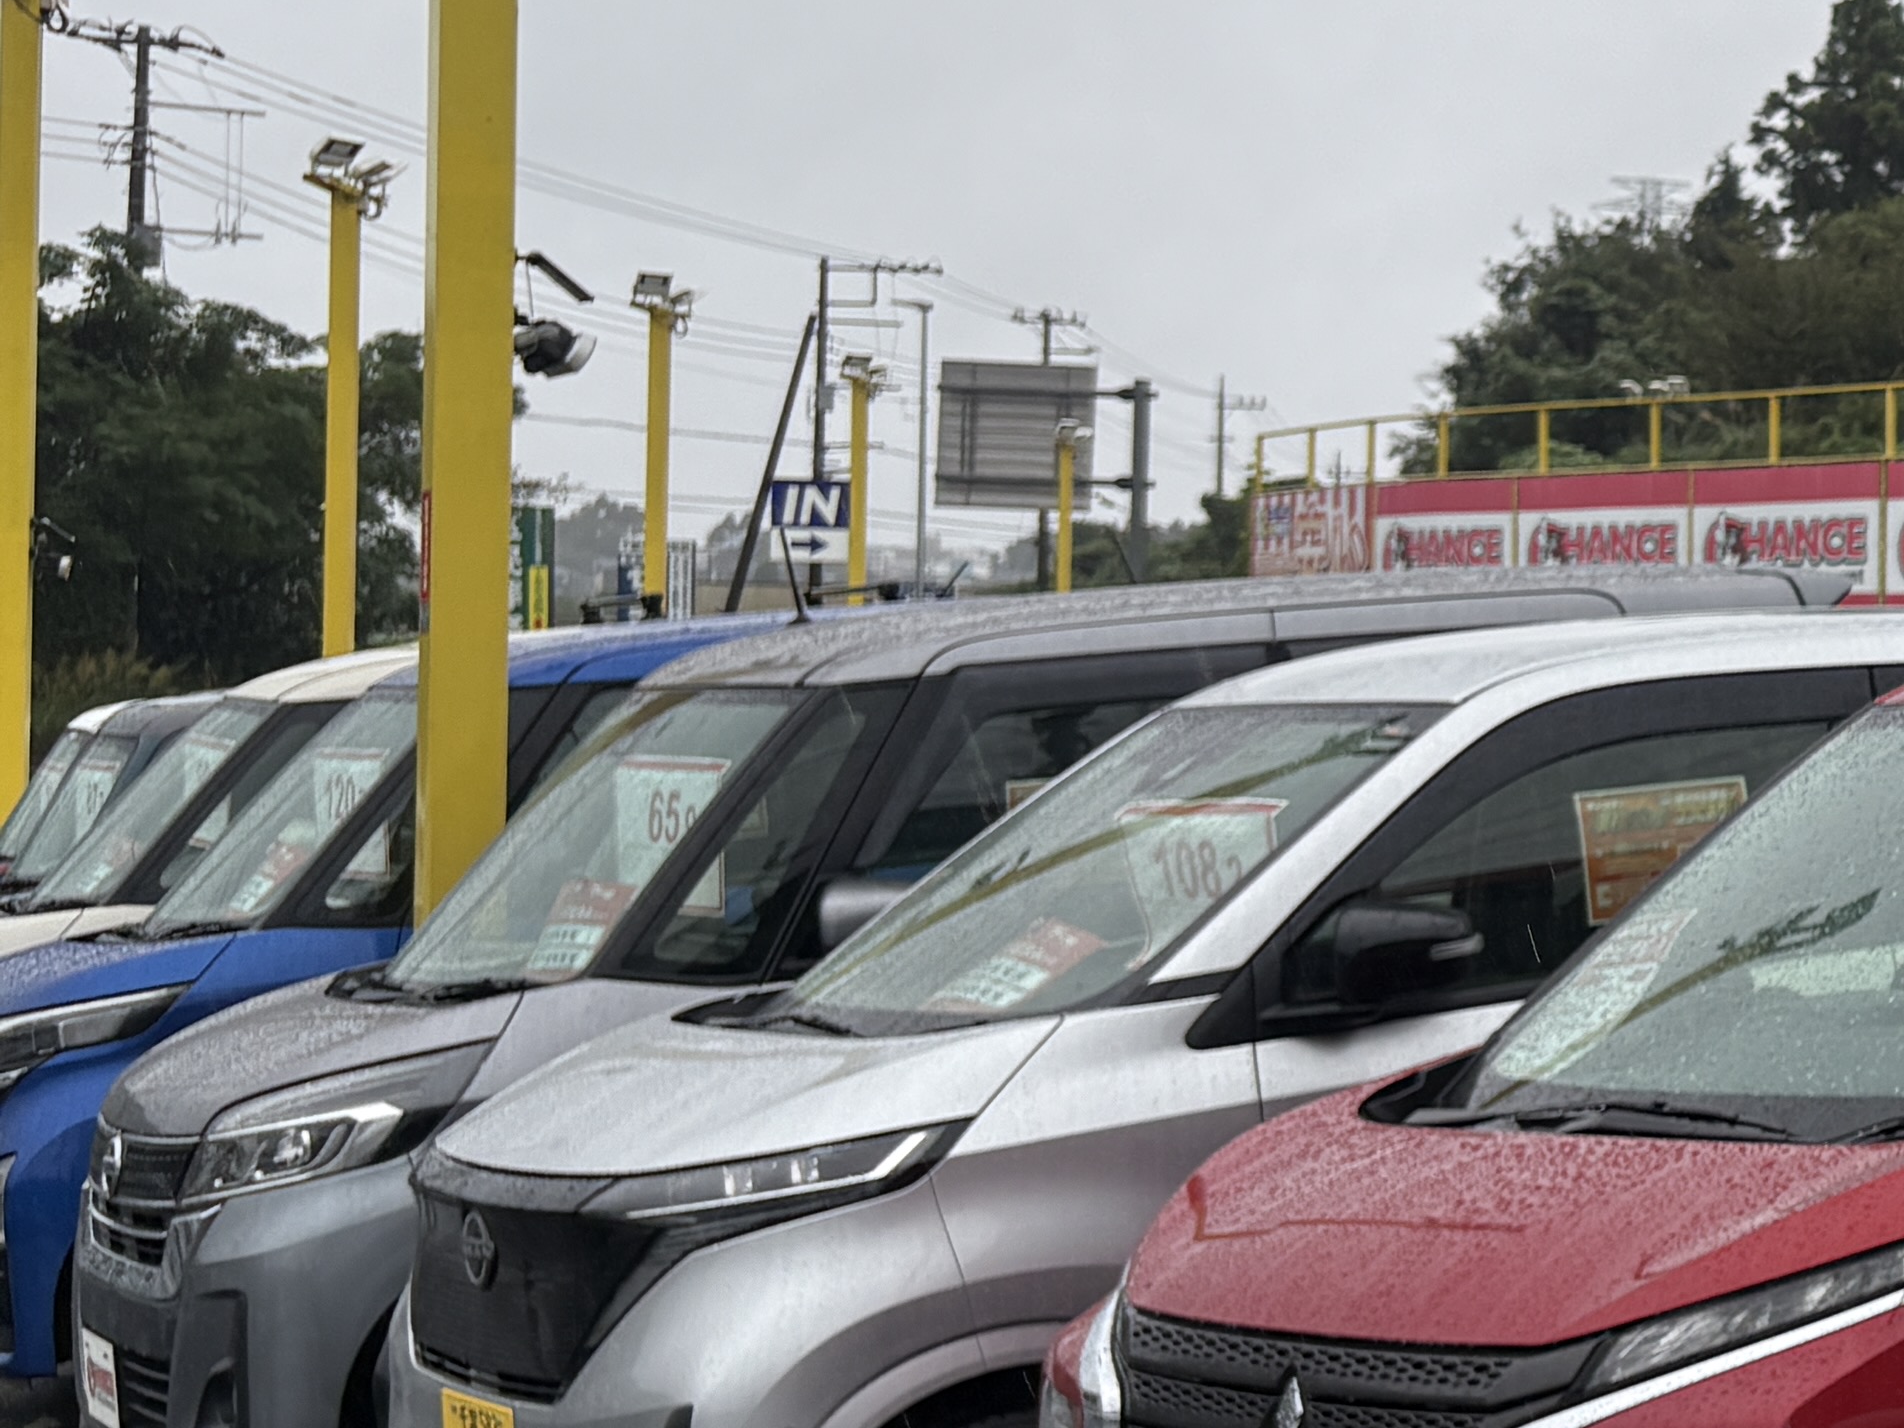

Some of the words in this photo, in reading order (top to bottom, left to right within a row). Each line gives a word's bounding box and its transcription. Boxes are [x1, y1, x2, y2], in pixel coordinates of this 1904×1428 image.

[781, 483, 844, 527] IN
[1381, 525, 1504, 572] CHANCE
[1527, 522, 1679, 568] CHANCE
[1704, 516, 1868, 568] CHANCE
